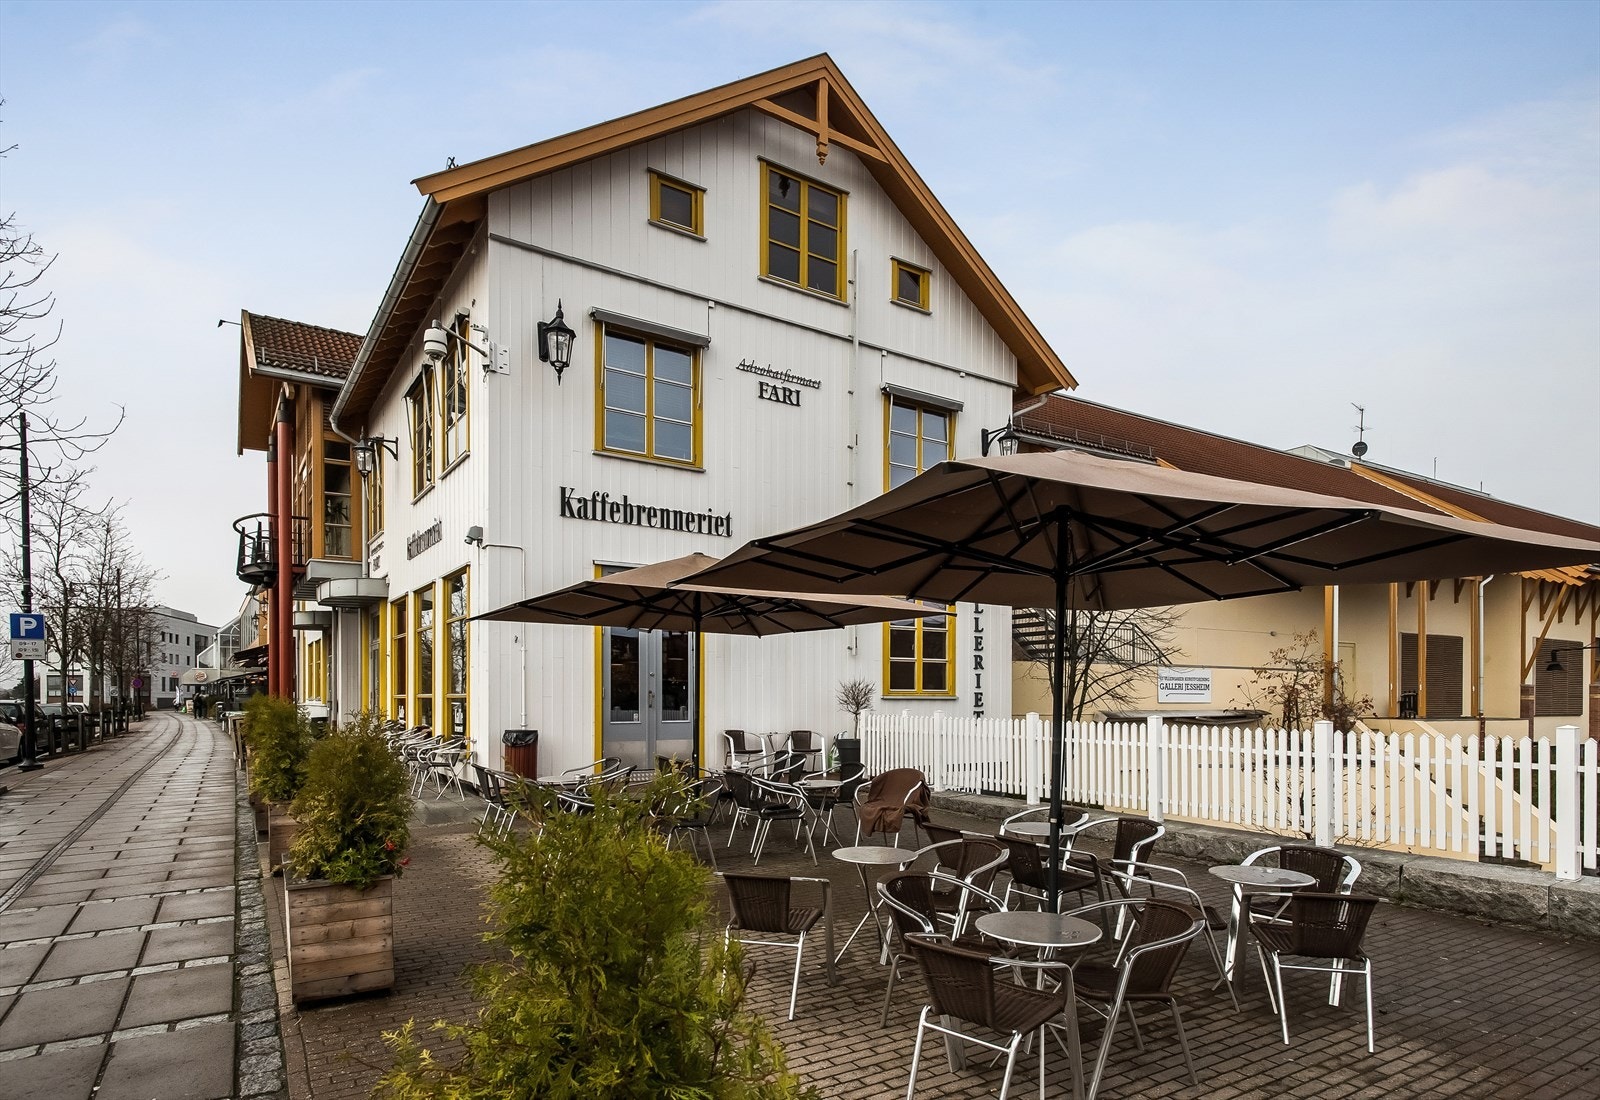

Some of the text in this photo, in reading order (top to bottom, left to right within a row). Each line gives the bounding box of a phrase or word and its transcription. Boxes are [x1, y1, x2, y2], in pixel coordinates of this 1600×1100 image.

[735, 358, 821, 389] Advokatfirmaet
[758, 380, 801, 407] FARI
[559, 485, 733, 538] Kaffebrenneriet
[19, 617, 38, 637] P
[1159, 682, 1210, 691] GALLERI JESSHEIM
